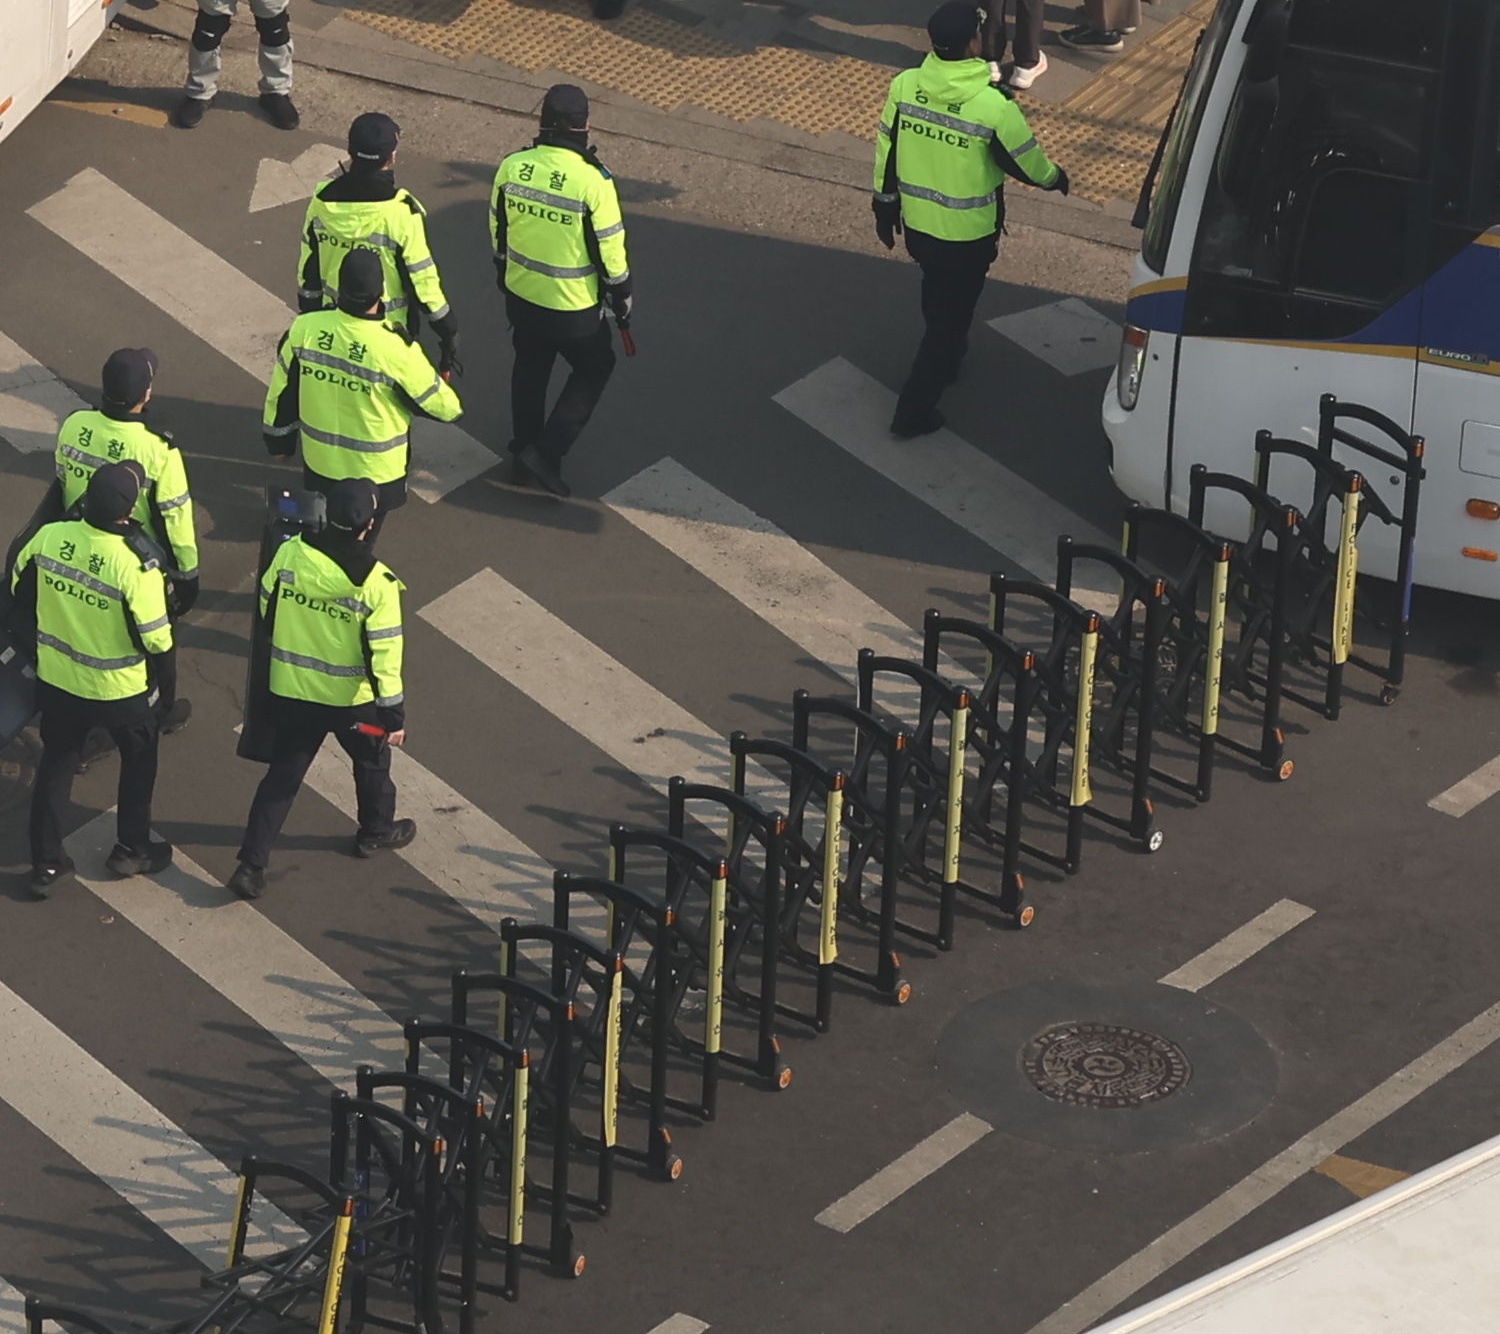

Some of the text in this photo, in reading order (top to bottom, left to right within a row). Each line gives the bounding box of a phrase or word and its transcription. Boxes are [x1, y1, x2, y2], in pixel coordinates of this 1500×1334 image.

[900, 119, 970, 149] POLICE
[507, 198, 574, 226] POLICE
[301, 366, 372, 397] POLICE
[45, 574, 110, 611] POLICE
[281, 587, 352, 624] POLICE
